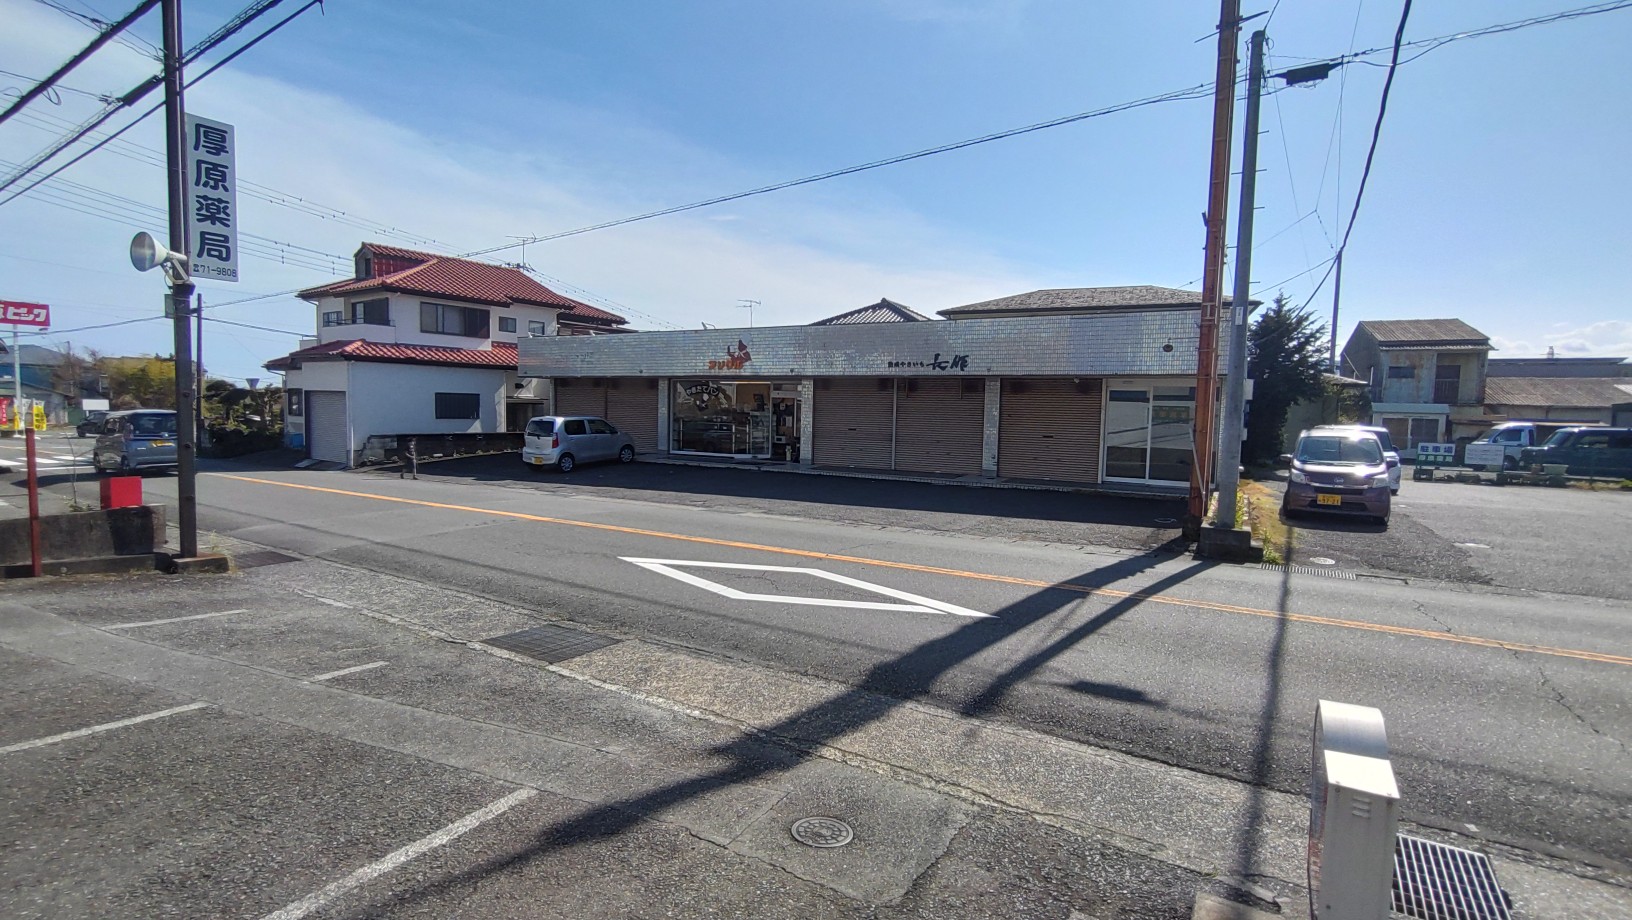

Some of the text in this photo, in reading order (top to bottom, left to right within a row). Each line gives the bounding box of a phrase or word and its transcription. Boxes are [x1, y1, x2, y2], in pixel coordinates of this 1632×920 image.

[193, 122, 232, 263] 厚原薬局
[199, 264, 237, 278] 71-9808
[1420, 445, 1453, 454] 駐車場
